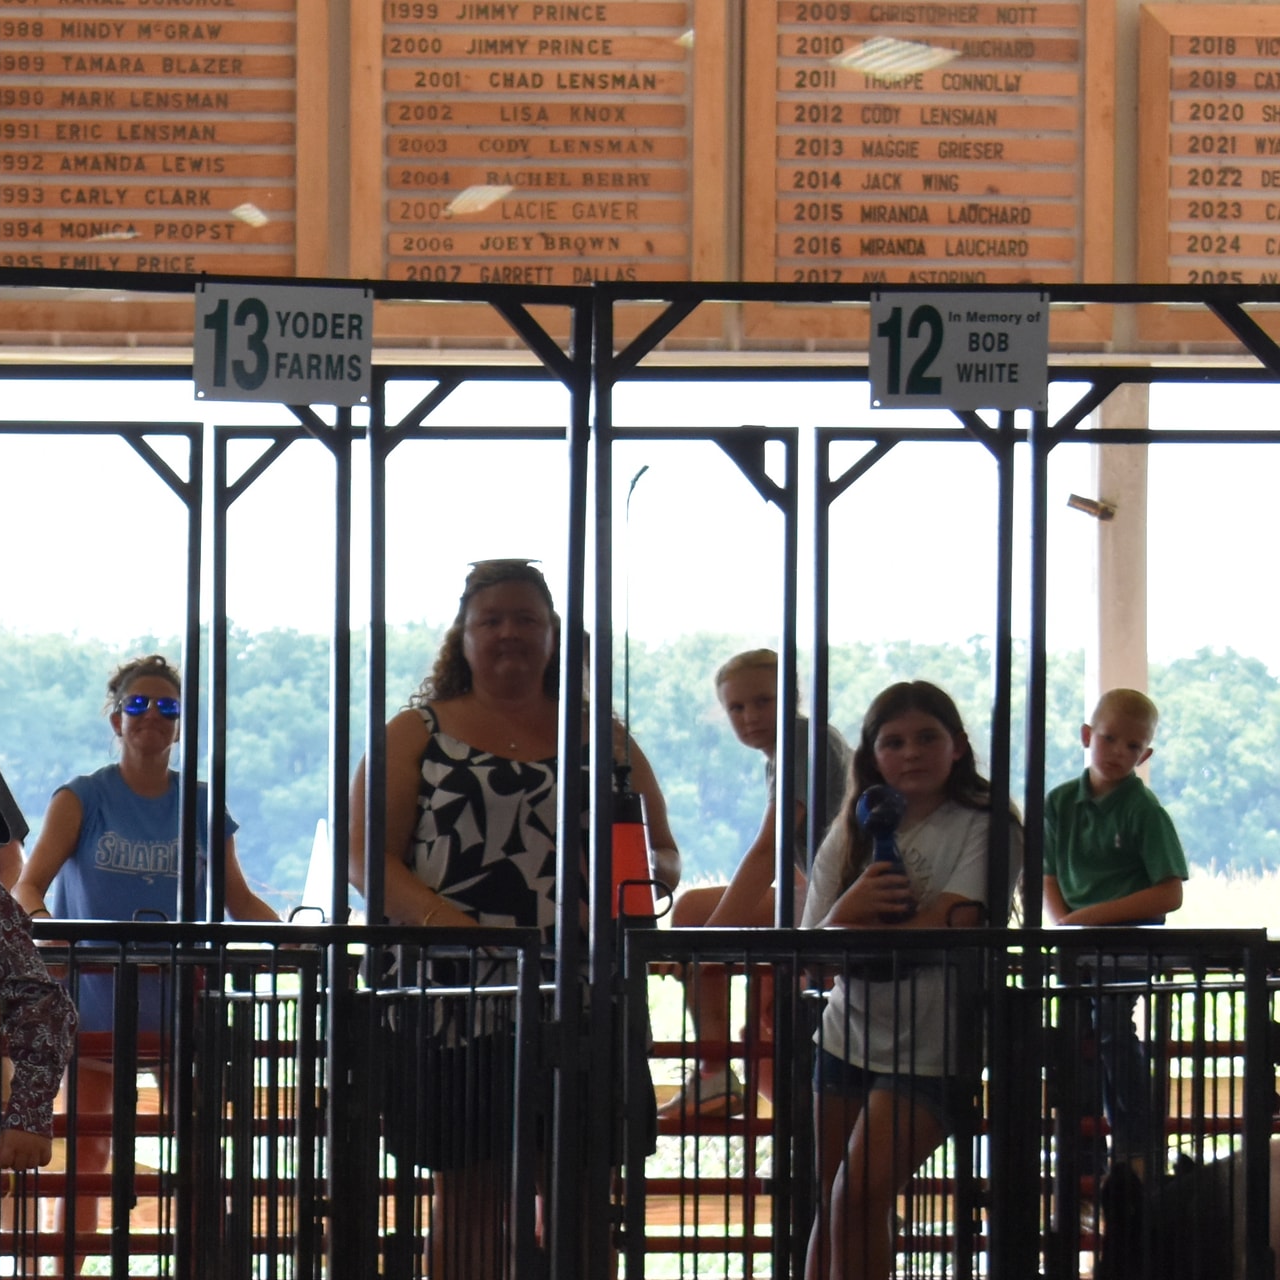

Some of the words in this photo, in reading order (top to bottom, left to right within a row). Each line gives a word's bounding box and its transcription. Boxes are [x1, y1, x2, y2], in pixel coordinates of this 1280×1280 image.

[390, 3, 438, 18] 1999
[456, 5, 518, 21] JIMMY
[533, 6, 606, 21] PRINCE
[796, 4, 851, 21] 2009
[870, 6, 978, 23] CHRISTOPHER
[997, 7, 1036, 24] NOTT
[61, 23, 124, 38] MINDY
[390, 38, 442, 53] 2000
[466, 39, 528, 55] JIMMY
[539, 39, 612, 55] PRINCE
[1190, 38, 1236, 54] 2018
[63, 57, 144, 72] TAMARA
[163, 59, 243, 73] BLAZER
[415, 72, 460, 88] 2001
[489, 73, 544, 88] CHAD
[557, 73, 656, 89] LENSMAN
[399, 106, 452, 121] 2002
[501, 106, 548, 122] LISA
[570, 106, 627, 122] KNOX
[795, 106, 842, 122] 2012
[861, 107, 900, 124] CODY
[921, 109, 997, 126] LENSMAN
[1190, 104, 1243, 121] 2020
[56, 125, 102, 140] ERIC
[118, 126, 216, 140] LENSMAN
[795, 139, 842, 156] 2013
[862, 141, 919, 158] MAGGIE
[938, 142, 1003, 159] GRIESER
[1188, 137, 1236, 154] 2021
[60, 157, 146, 171] AMANDA
[162, 158, 225, 172] LEWIS
[794, 172, 842, 189] 2014
[861, 174, 901, 190] JACK
[922, 175, 959, 192] WING
[60, 190, 127, 205] CARLY
[145, 191, 211, 205] CLARK
[502, 203, 557, 219] LACIE
[572, 202, 638, 219] GAVER
[794, 204, 842, 221] 2015
[861, 206, 928, 223] MIRANDA
[948, 207, 1031, 224] LAUCHARD
[1188, 202, 1242, 218] 2023
[154, 224, 235, 239] PROPST
[403, 238, 453, 251] 2006
[480, 238, 534, 251] JOEY
[544, 237, 620, 251] BROWN
[794, 238, 841, 254] 2016
[860, 239, 925, 256] MIRANDA
[946, 240, 1028, 257] LAUCHARD
[1187, 236, 1240, 253] 2024
[276, 311, 363, 340] YODER
[948, 312, 961, 322] In
[966, 312, 1020, 325] Memory
[1027, 312, 1041, 322] of
[204, 298, 269, 391] 13
[878, 305, 944, 394] 12
[968, 332, 1008, 352] BOB
[275, 353, 361, 382] FARMS
[957, 363, 1018, 383] WHITE
